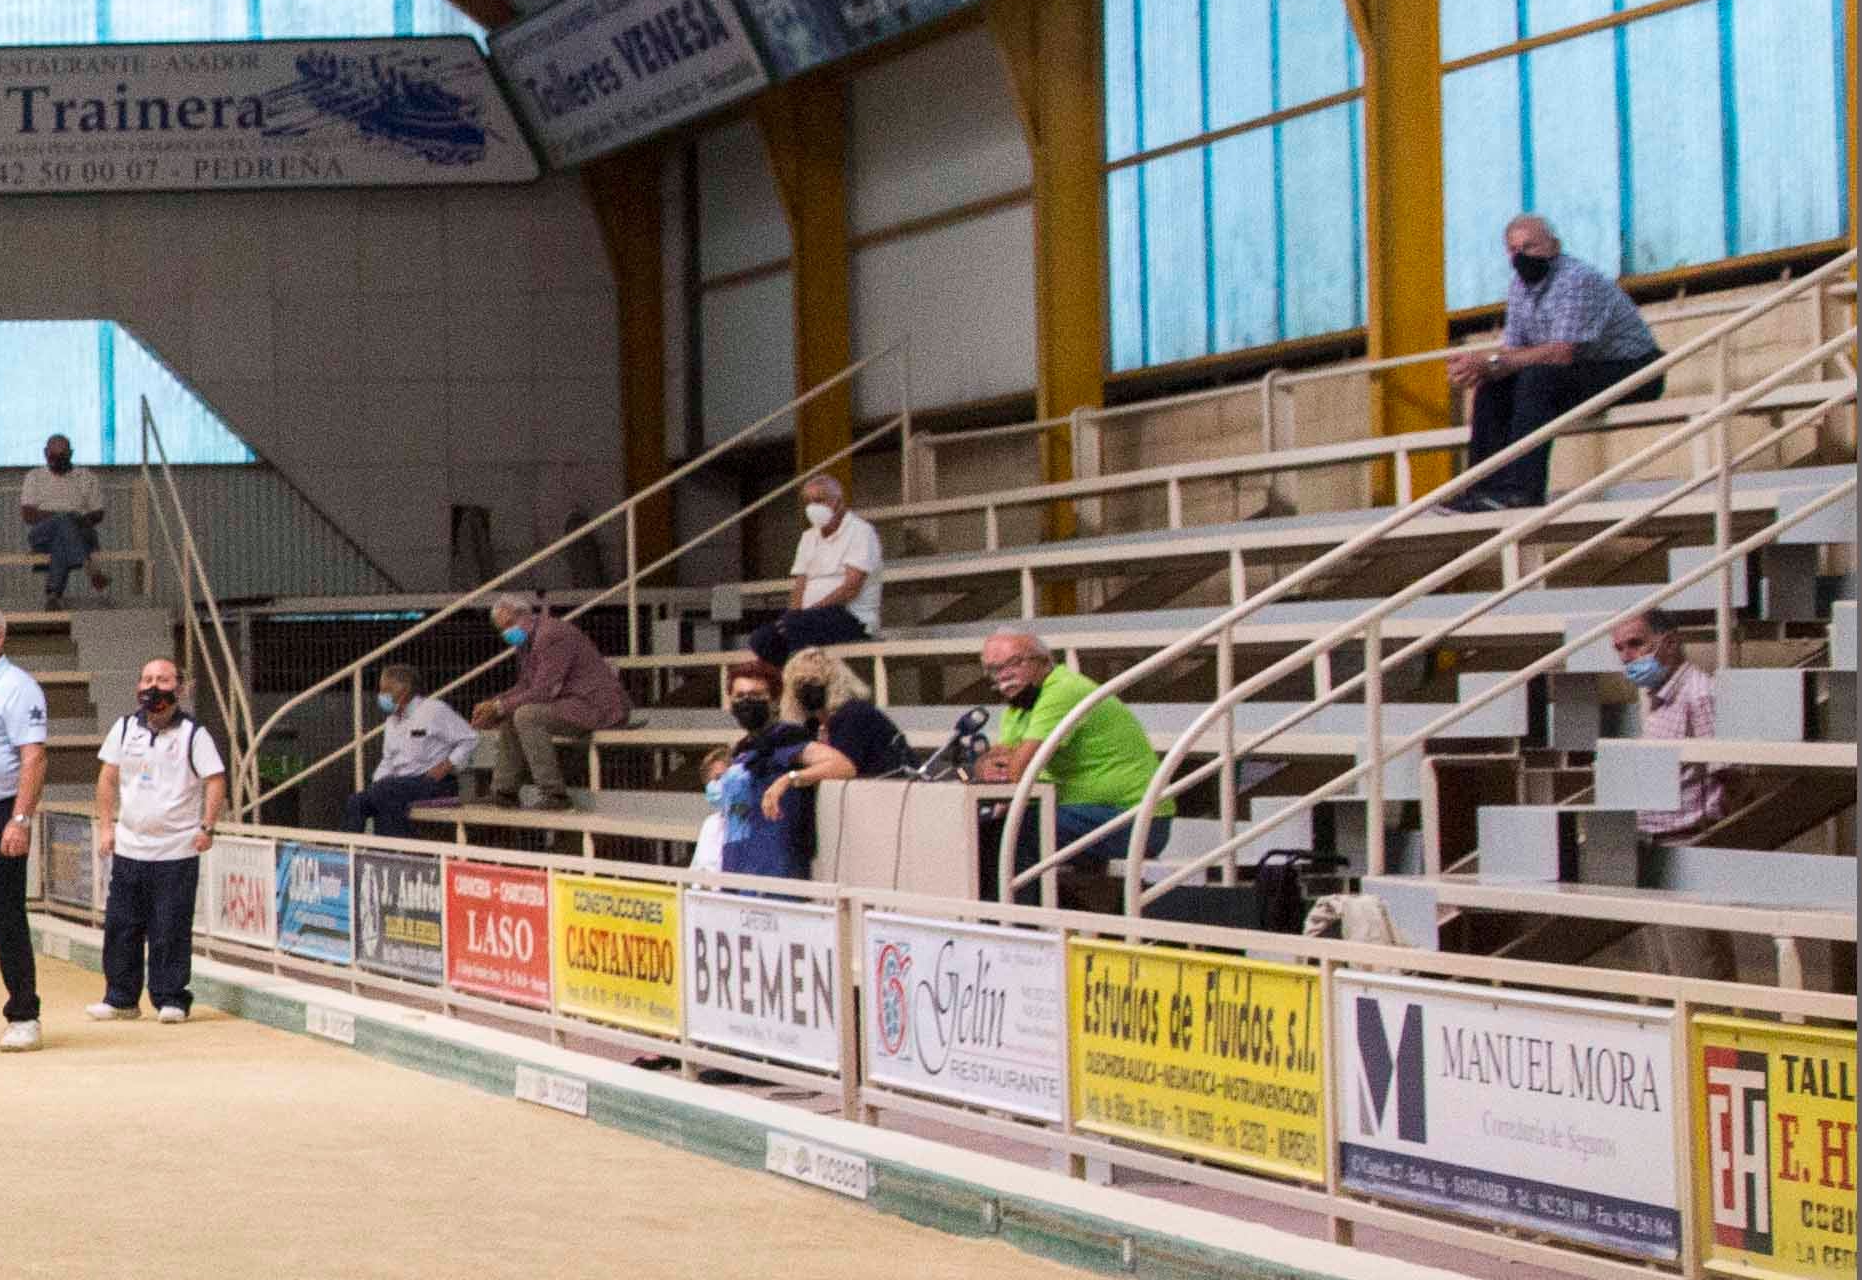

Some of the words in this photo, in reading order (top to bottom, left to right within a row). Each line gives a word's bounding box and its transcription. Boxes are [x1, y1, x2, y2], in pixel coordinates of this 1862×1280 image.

[165, 52, 260, 73] ASADOR
[5, 84, 267, 133] Trainera
[37, 162, 72, 184] 50
[82, 161, 116, 183] 00
[125, 160, 160, 182] 07
[192, 152, 345, 182] PEDREÑA
[573, 889, 664, 926] CONSTRUCCIONES
[466, 909, 535, 963] LASO
[565, 923, 675, 986] CASTANEDO
[693, 926, 837, 1030] BREMEN
[913, 938, 1008, 1077] Gelín
[1083, 952, 1160, 1047] Estudios
[1168, 959, 1194, 1053] de
[1202, 968, 1281, 1074] Fluidos,
[949, 1058, 1061, 1101] RESTAURANTE
[1441, 1025, 1563, 1096] MANUEL
[1569, 1043, 1663, 1113] MORA
[1566, 1126, 1619, 1163] Seguros
